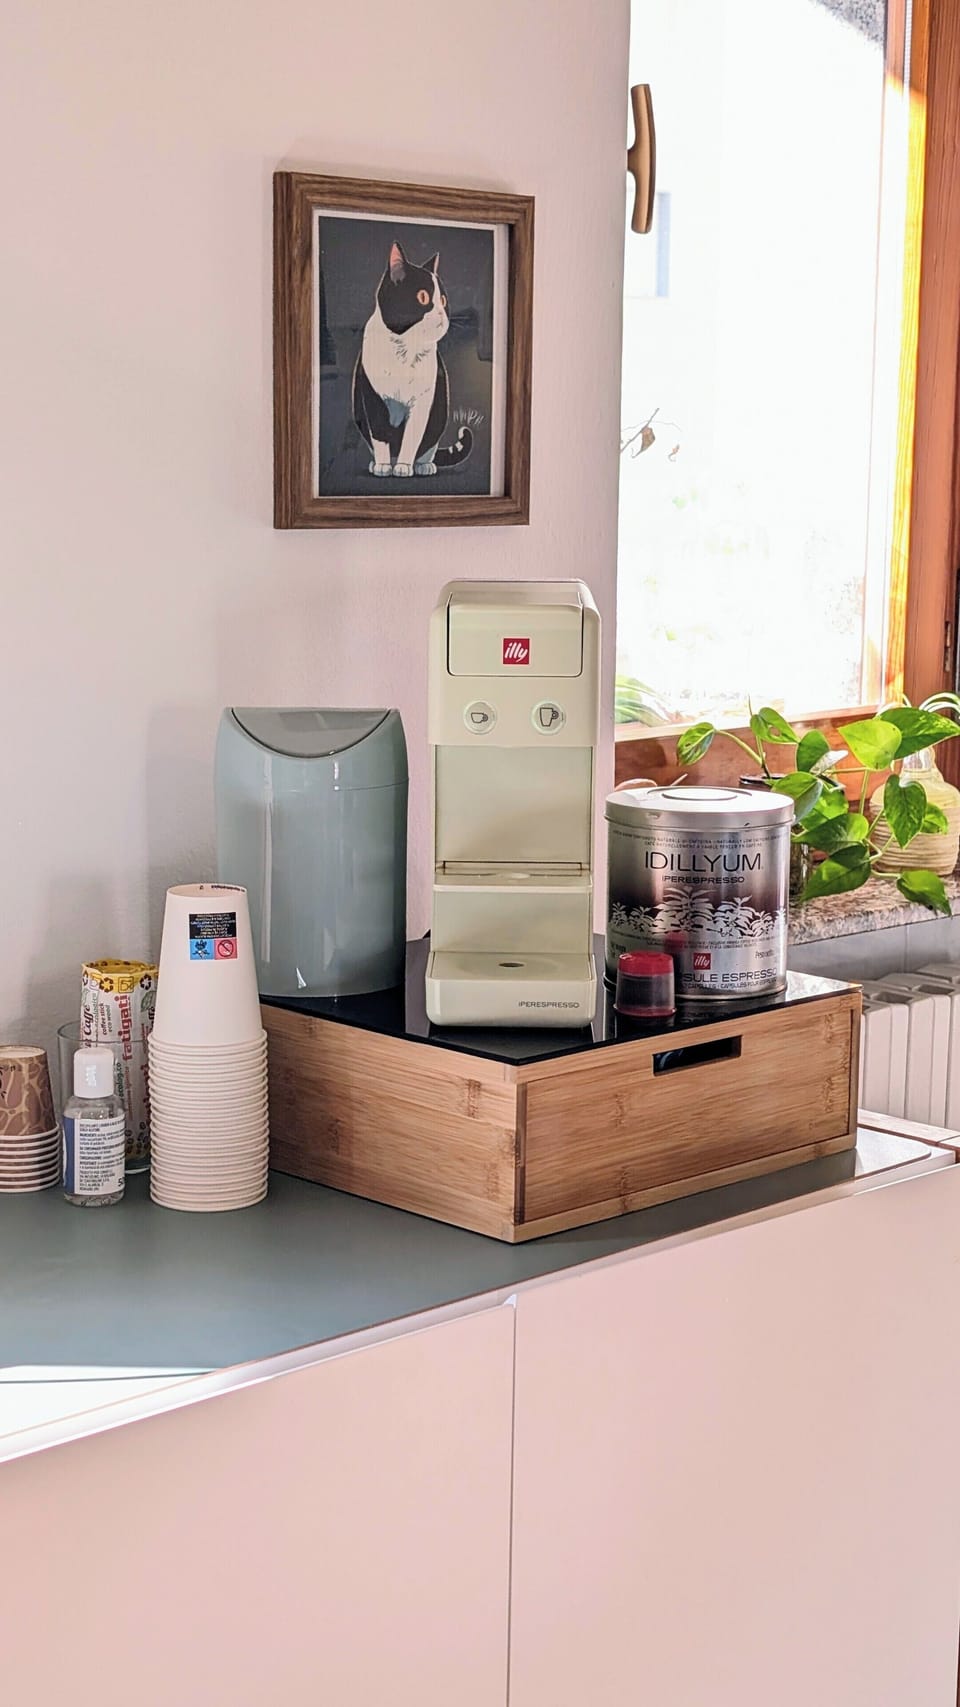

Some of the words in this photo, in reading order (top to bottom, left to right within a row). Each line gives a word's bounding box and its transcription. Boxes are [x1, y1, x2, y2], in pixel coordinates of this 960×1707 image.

[504, 642, 528, 662] illy
[645, 850, 763, 873] IDILLYUM
[694, 955, 710, 968] illy
[683, 972, 718, 982] SULE
[113, 994, 132, 1061] fatigati
